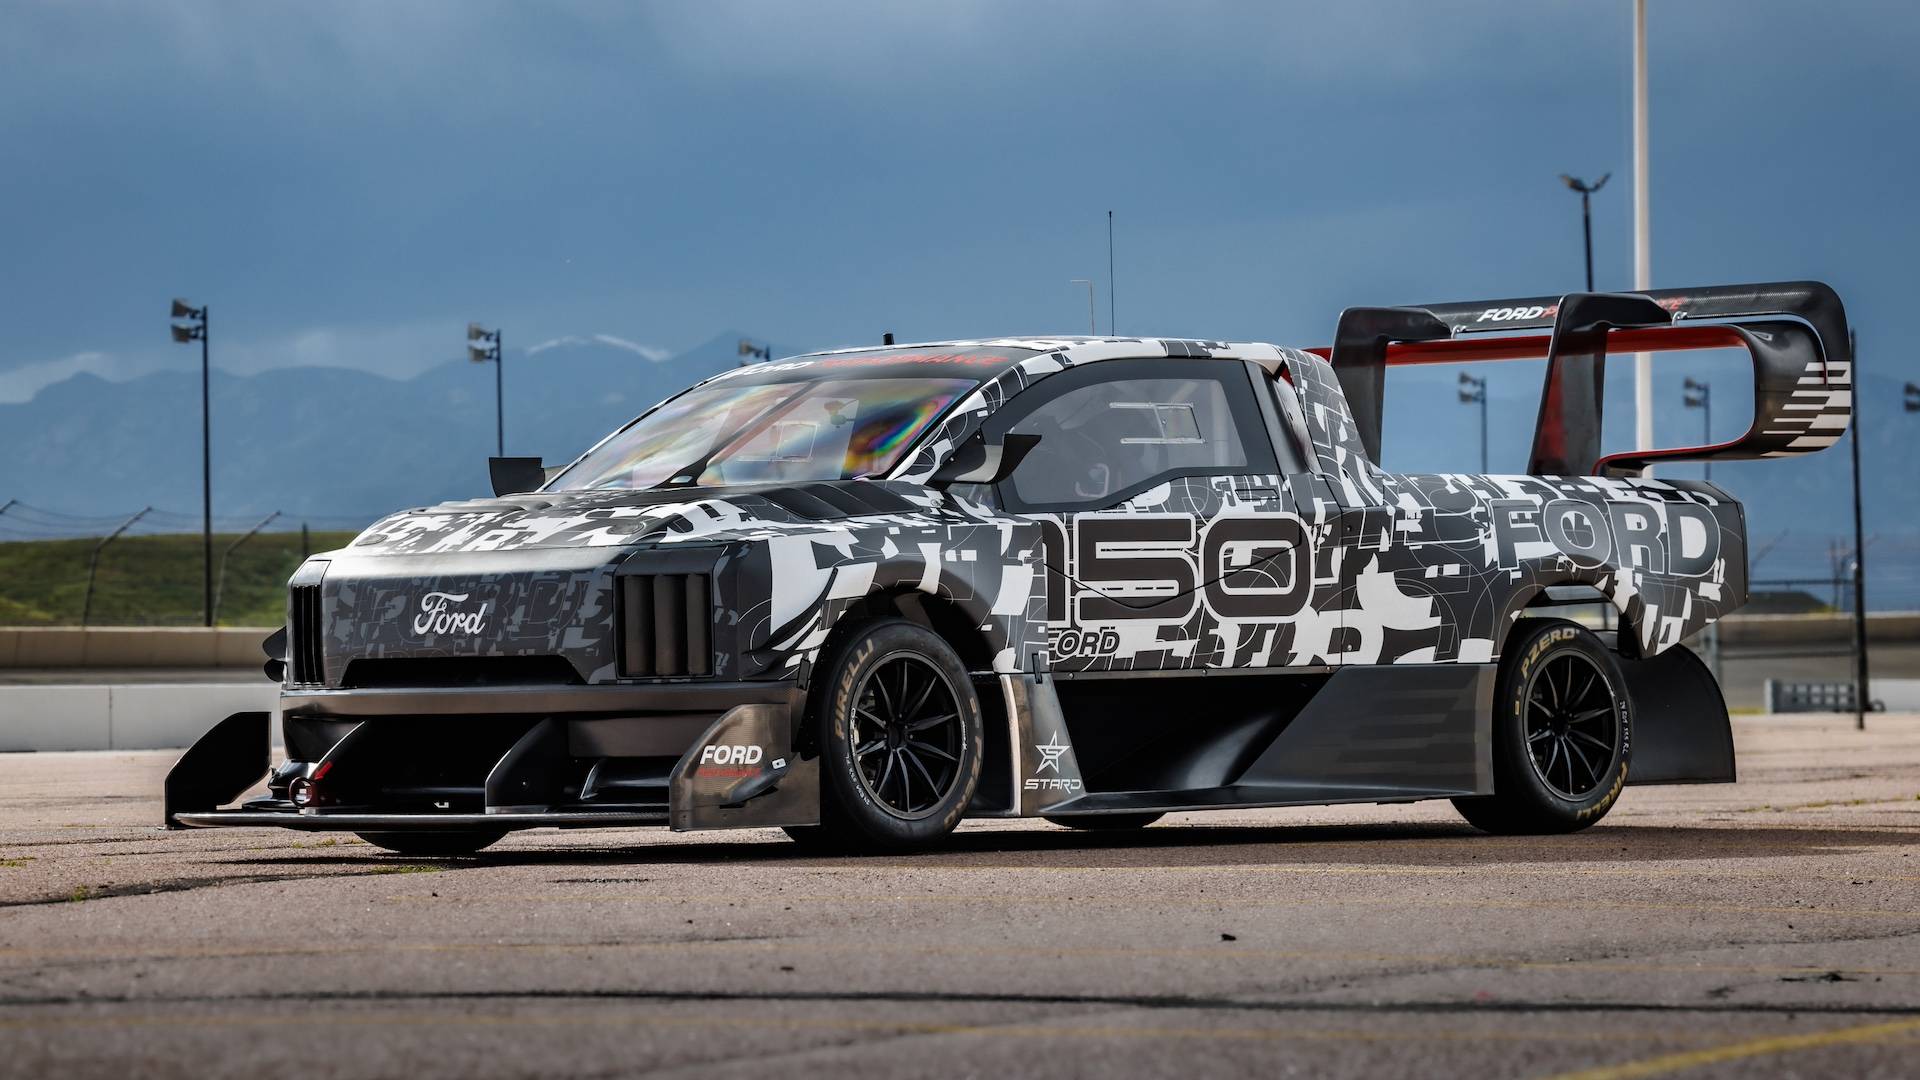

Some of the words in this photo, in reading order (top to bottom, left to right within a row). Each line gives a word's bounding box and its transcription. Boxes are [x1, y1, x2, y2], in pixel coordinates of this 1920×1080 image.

[1477, 306, 1544, 322] FORD
[1489, 498, 1722, 578] FORD
[1041, 512, 1315, 627] 150
[413, 591, 488, 635] Ford
[834, 638, 874, 740] PIRELLI
[700, 745, 763, 765] FORD
[1024, 778, 1081, 794] STARD
